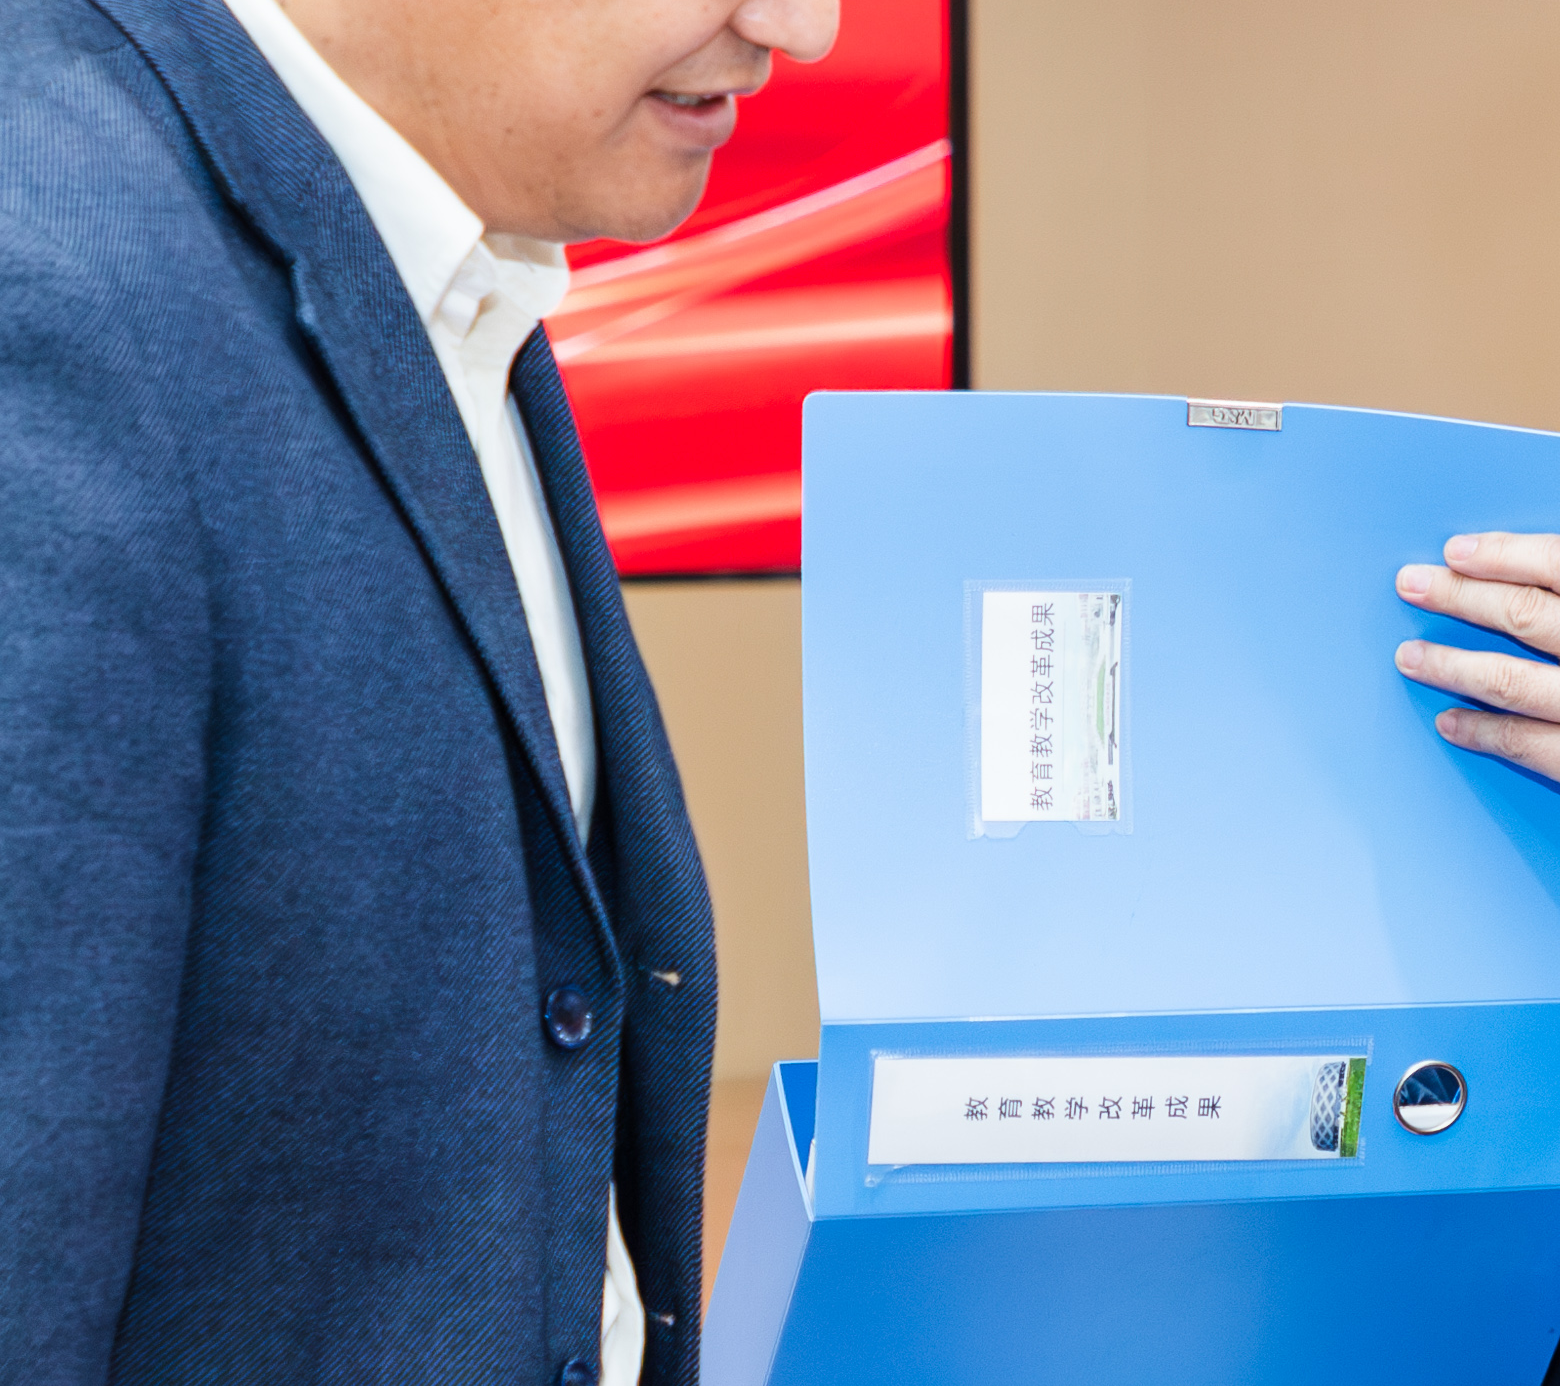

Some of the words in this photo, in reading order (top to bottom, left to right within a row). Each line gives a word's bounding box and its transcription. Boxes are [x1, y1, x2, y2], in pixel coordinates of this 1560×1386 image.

[1029, 602, 1055, 811] 教育教学改革成果
[963, 1094, 1223, 1121] 教育教学改革成果
